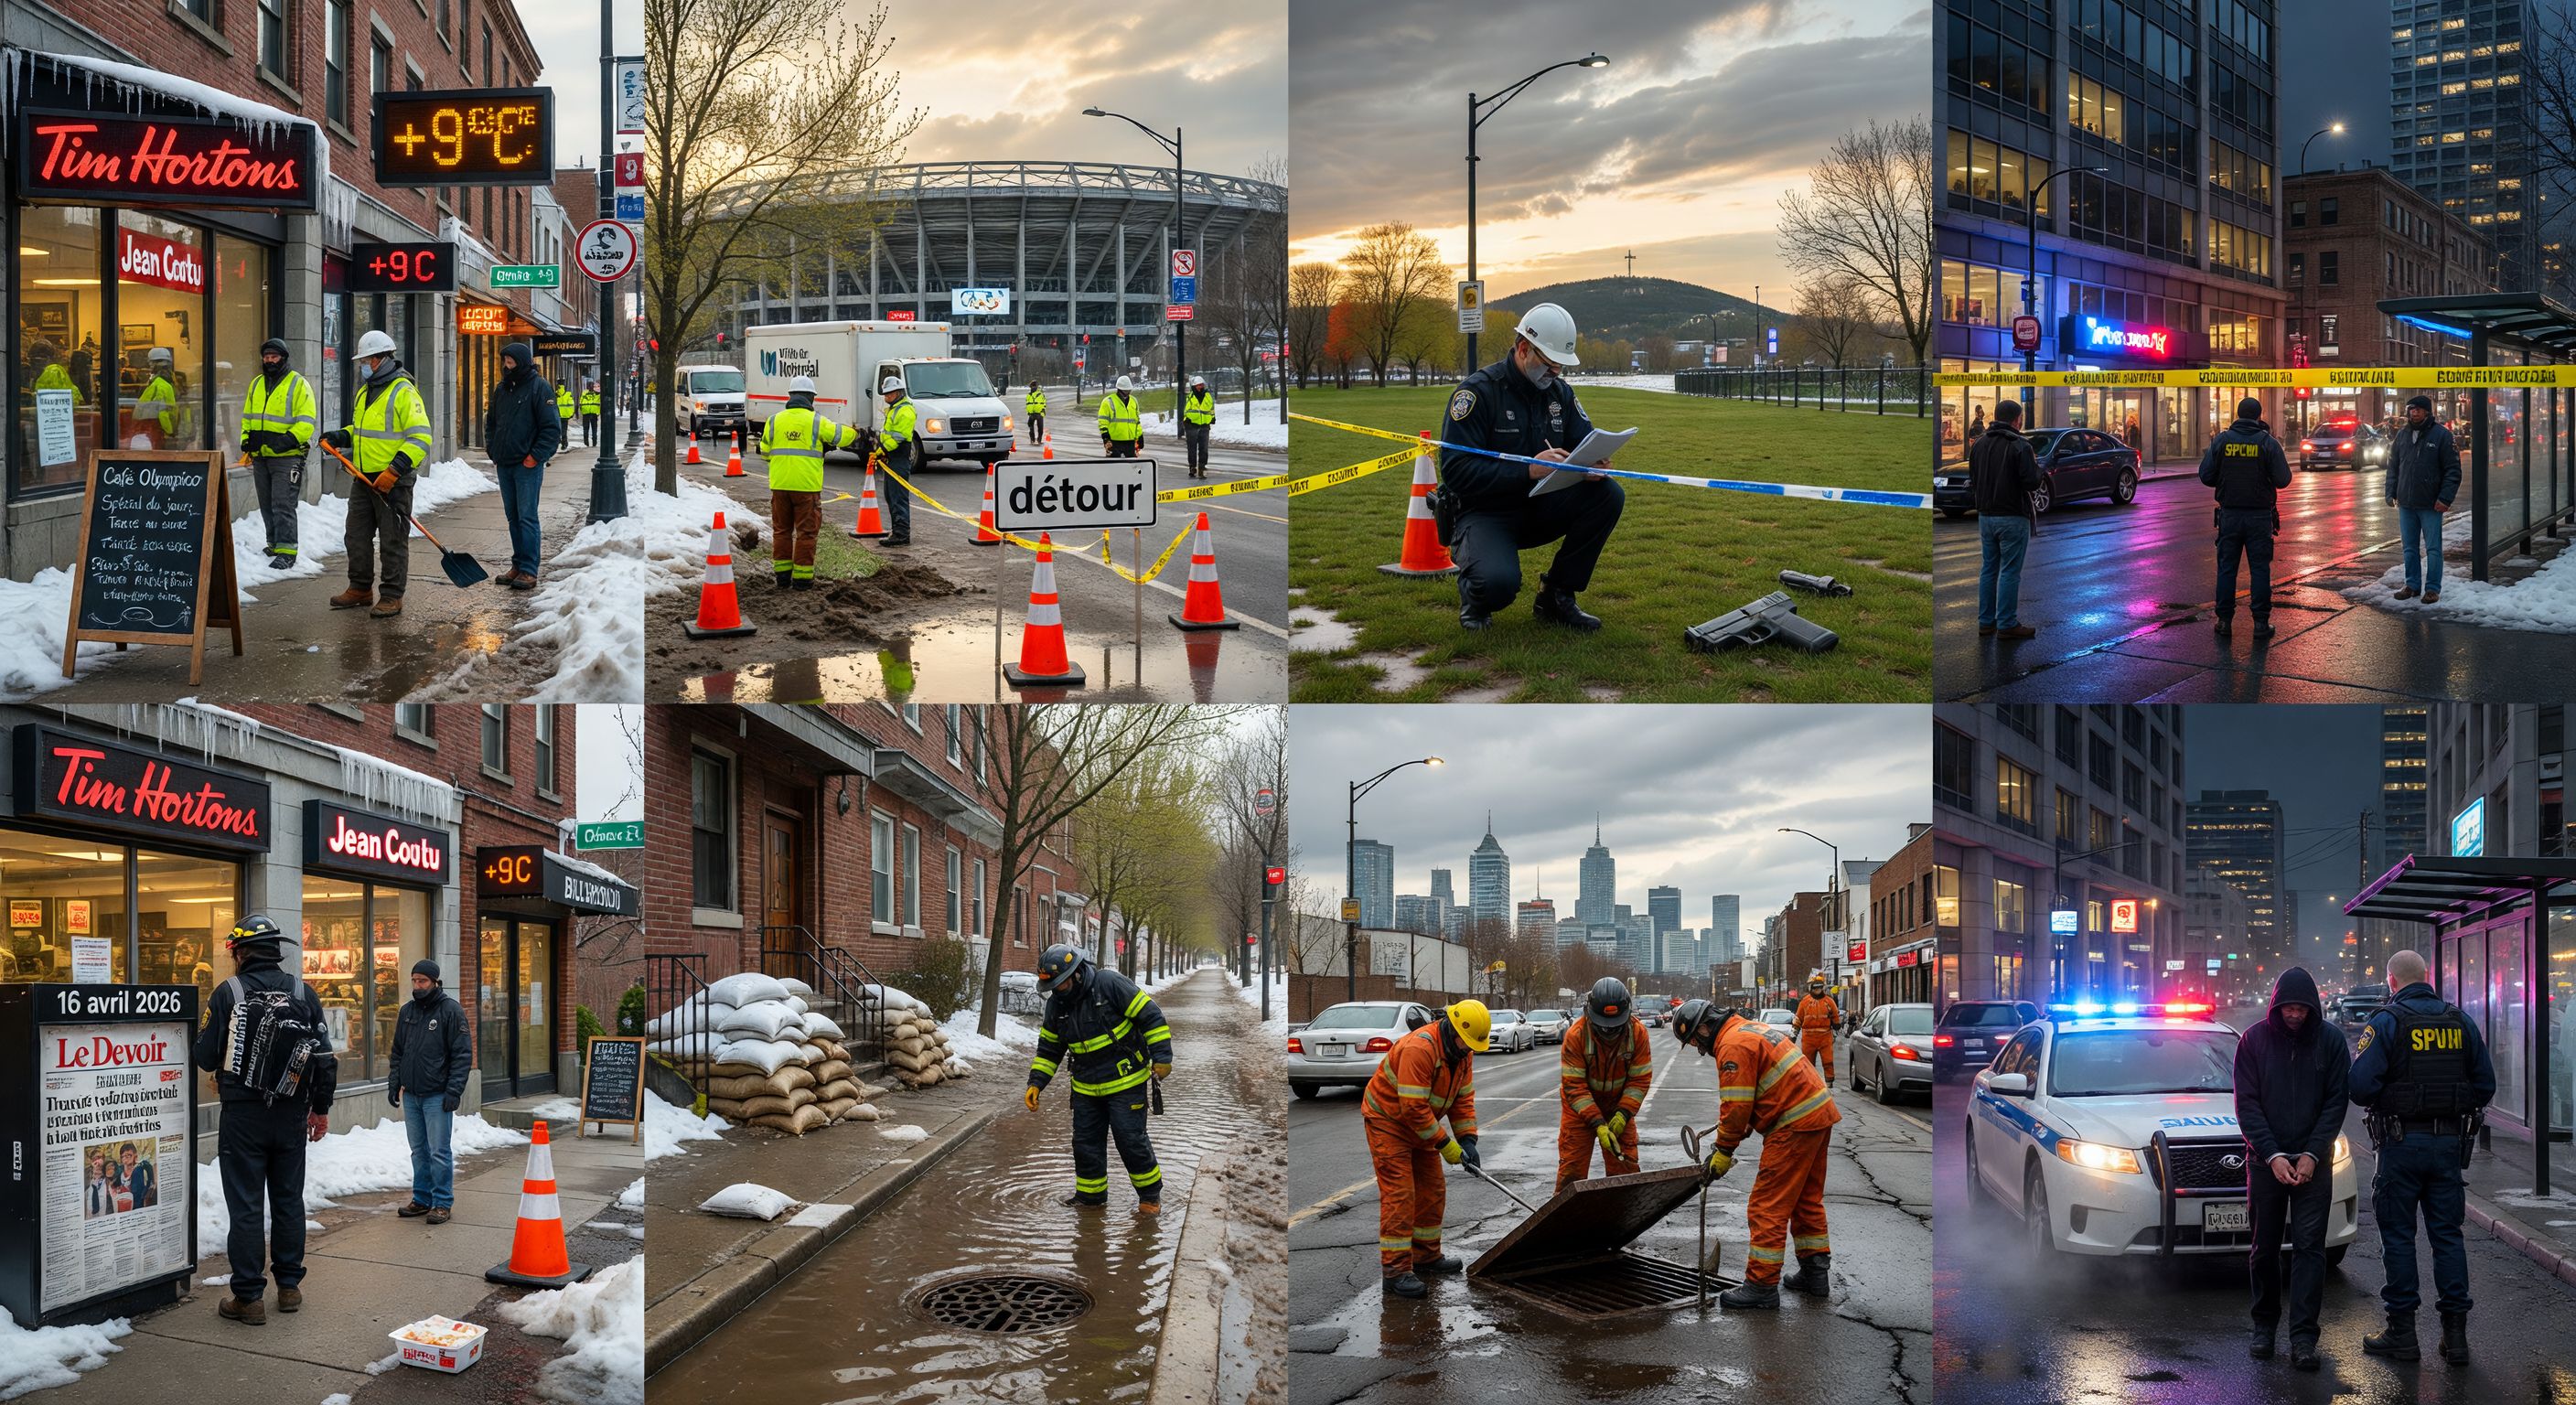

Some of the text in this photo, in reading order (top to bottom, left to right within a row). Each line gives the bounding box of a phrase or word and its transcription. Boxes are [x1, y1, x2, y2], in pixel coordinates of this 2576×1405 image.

[37, 124, 120, 181] Tim
[121, 234, 160, 277] Jean
[1009, 474, 1143, 514] détour
[53, 747, 125, 814] Tim
[328, 815, 382, 860] Jean
[485, 855, 531, 884] +9C
[57, 990, 181, 1014] 16 avril 2026
[56, 1032, 167, 1068] Le Devoir
